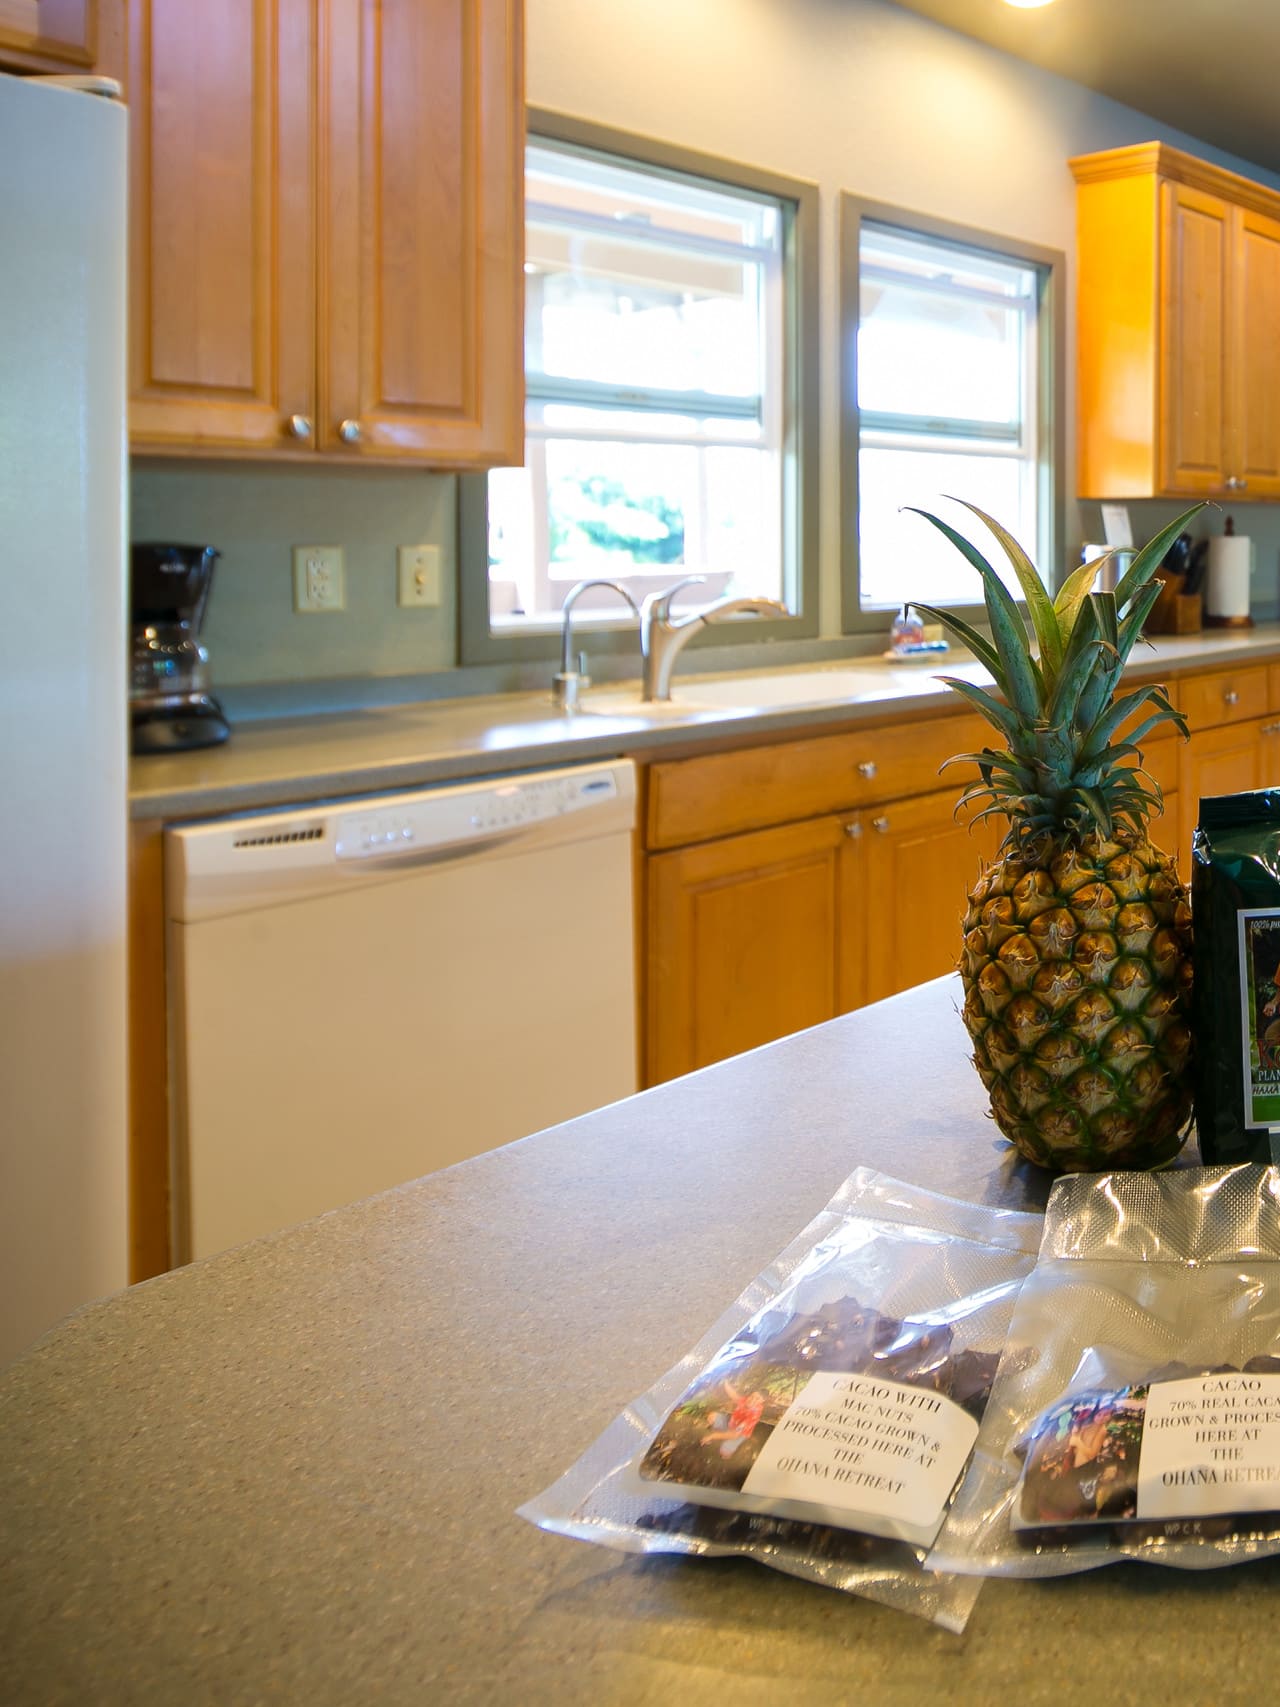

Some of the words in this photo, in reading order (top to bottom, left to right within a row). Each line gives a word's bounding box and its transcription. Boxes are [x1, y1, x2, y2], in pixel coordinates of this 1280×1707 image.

[1202, 1379, 1261, 1393] CACAO
[833, 1379, 890, 1400] CACAO
[896, 1391, 943, 1414] WITH
[1170, 1400, 1197, 1412] 70%
[1201, 1397, 1240, 1409] REAL
[841, 1398, 872, 1413] MAC
[874, 1406, 914, 1424] NUTS
[825, 1411, 872, 1430] CACAO
[875, 1422, 934, 1447] GROWN
[1149, 1415, 1205, 1430] GROWN
[1209, 1416, 1219, 1425] &
[783, 1420, 868, 1448] PROCESSED
[872, 1439, 913, 1460] HERE
[915, 1453, 936, 1470] AT
[1195, 1429, 1237, 1443] HERE
[1242, 1429, 1261, 1441] AT
[833, 1448, 864, 1466] THE
[1211, 1447, 1244, 1460] THE
[776, 1455, 829, 1478] OHANA
[833, 1468, 905, 1494] RETREAT
[1162, 1469, 1217, 1487] OHANA
